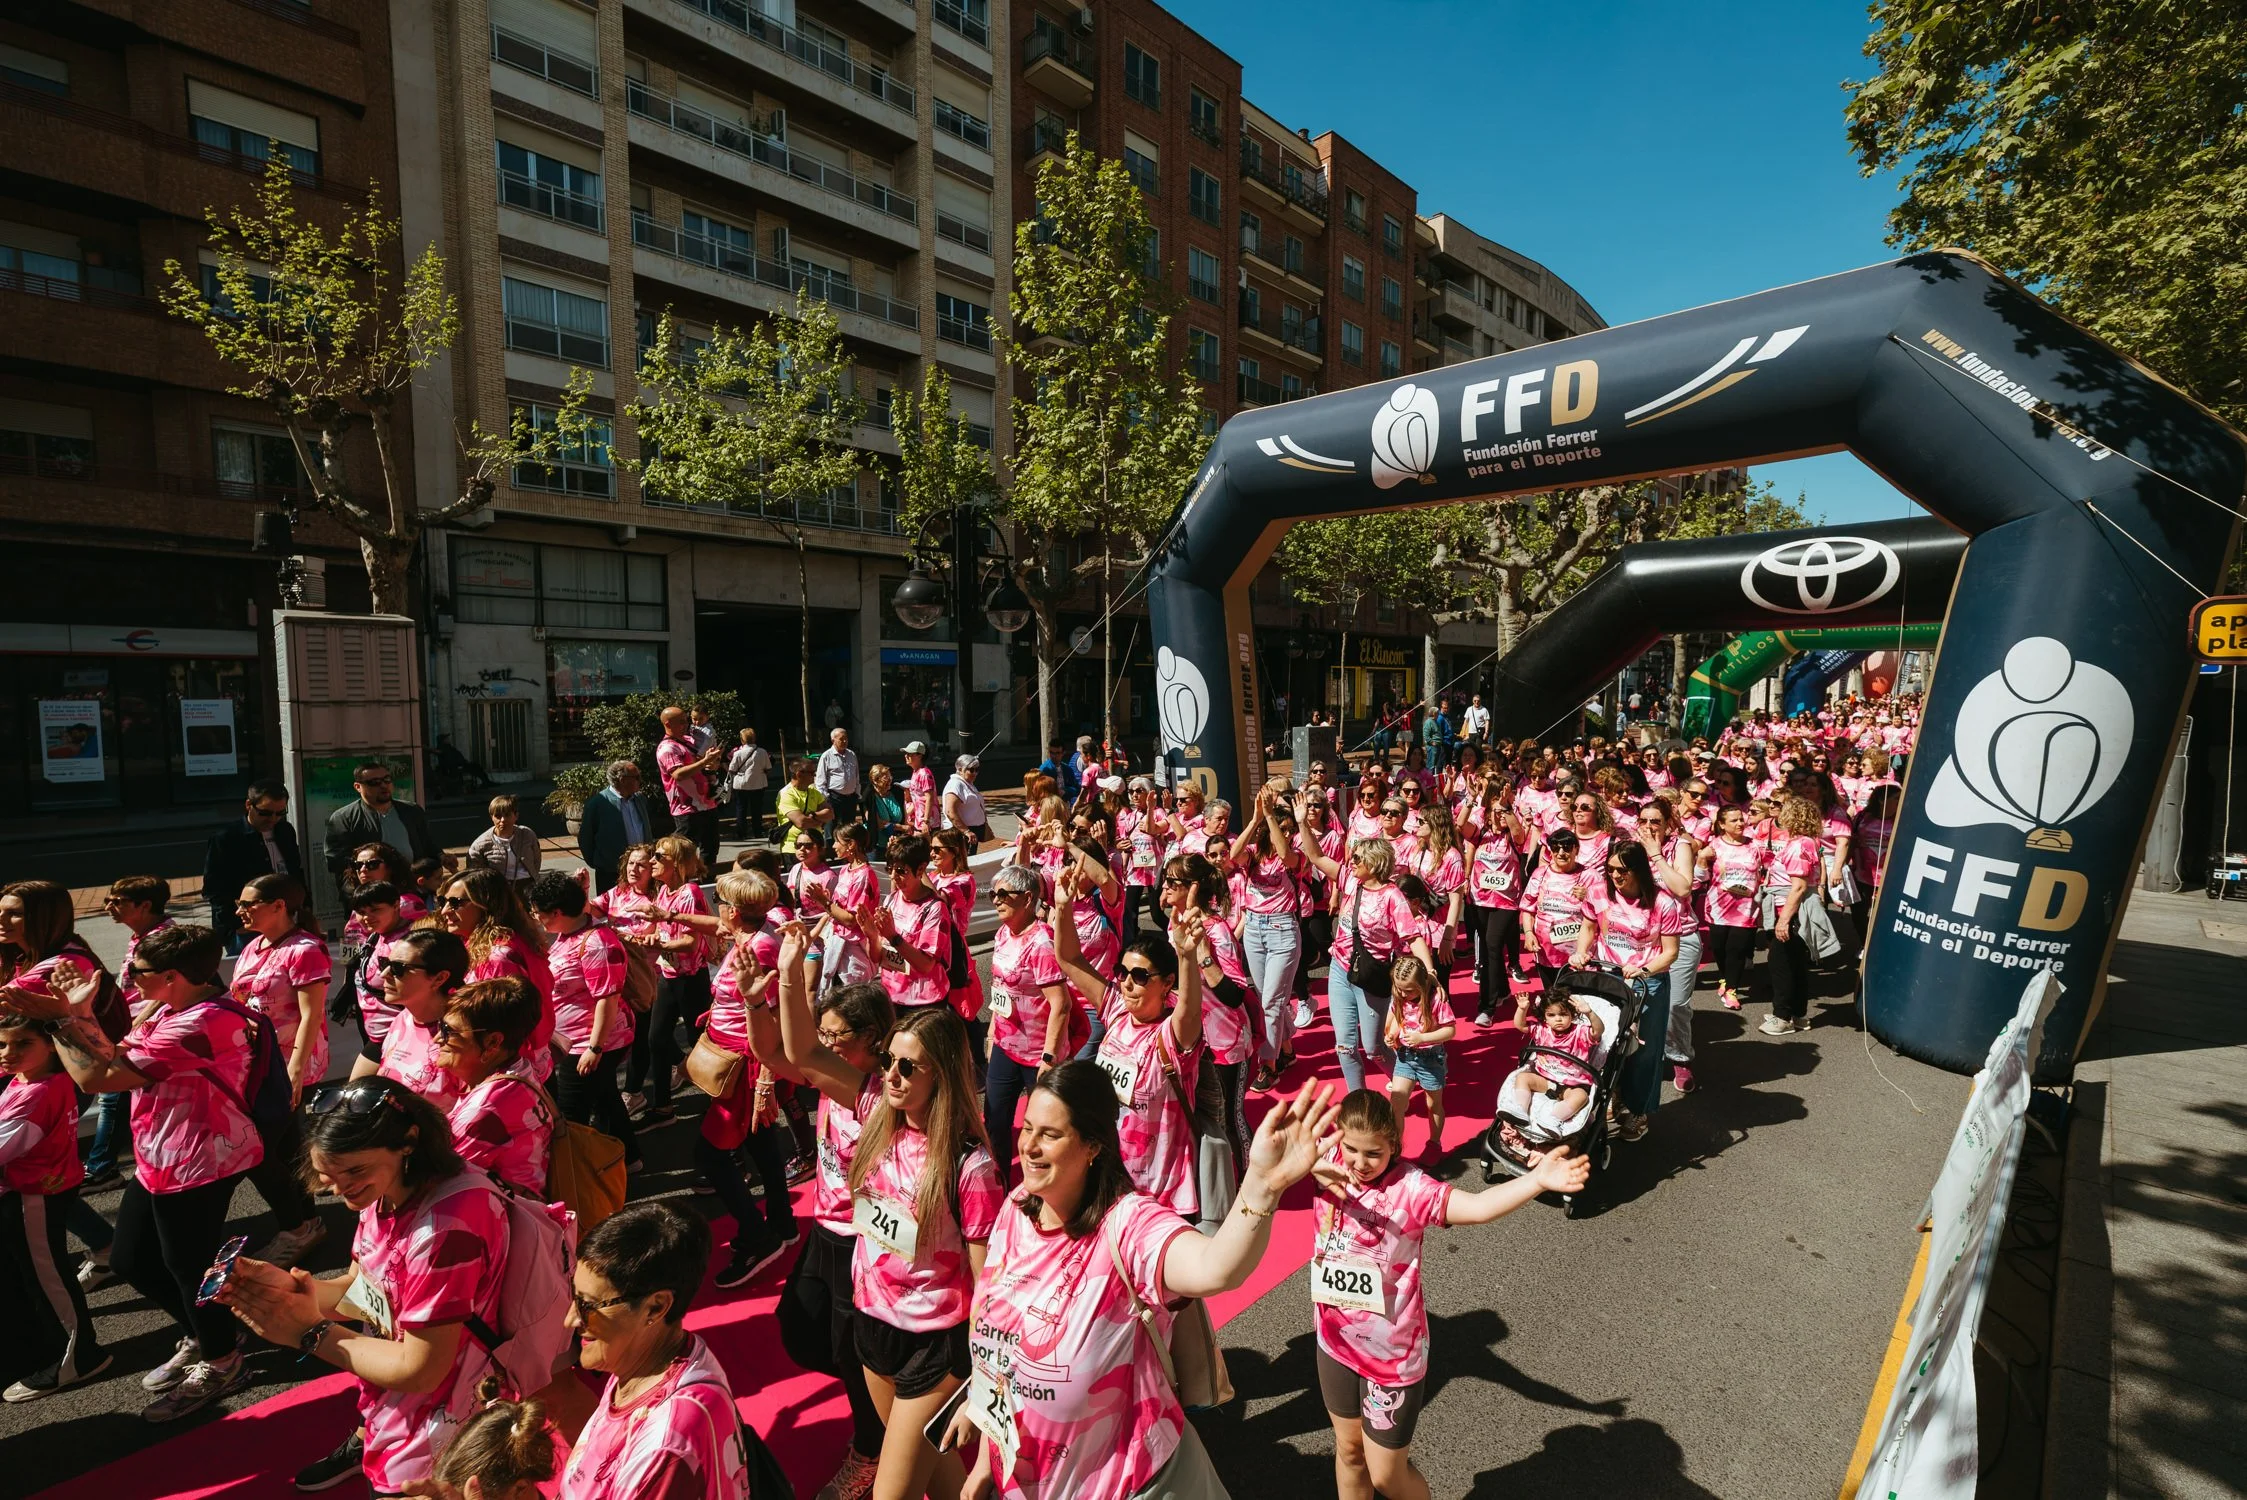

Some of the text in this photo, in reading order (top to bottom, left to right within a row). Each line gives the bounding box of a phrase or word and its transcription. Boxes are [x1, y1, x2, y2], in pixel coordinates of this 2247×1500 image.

[1460, 359, 1599, 443] FFD
[1462, 429, 1599, 462] Fundación Ferrer
[1467, 446, 1602, 479] para el Deporte
[909, 652, 940, 660] ANAGAN
[1360, 637, 1371, 664] El
[1715, 634, 1776, 680] PITILLOS
[1140, 855, 1148, 863] 15
[1484, 875, 1506, 886] 4653
[1902, 836, 2089, 932] FFD
[1551, 923, 1581, 937] 10959
[1897, 899, 2072, 955] Fundación Ferrer
[1893, 918, 2066, 974] para el Deporte
[871, 1205, 900, 1241] 241
[1322, 1266, 1373, 1296] 4828
[974, 1318, 1020, 1346] Carrera
[971, 1340, 1010, 1369] por la
